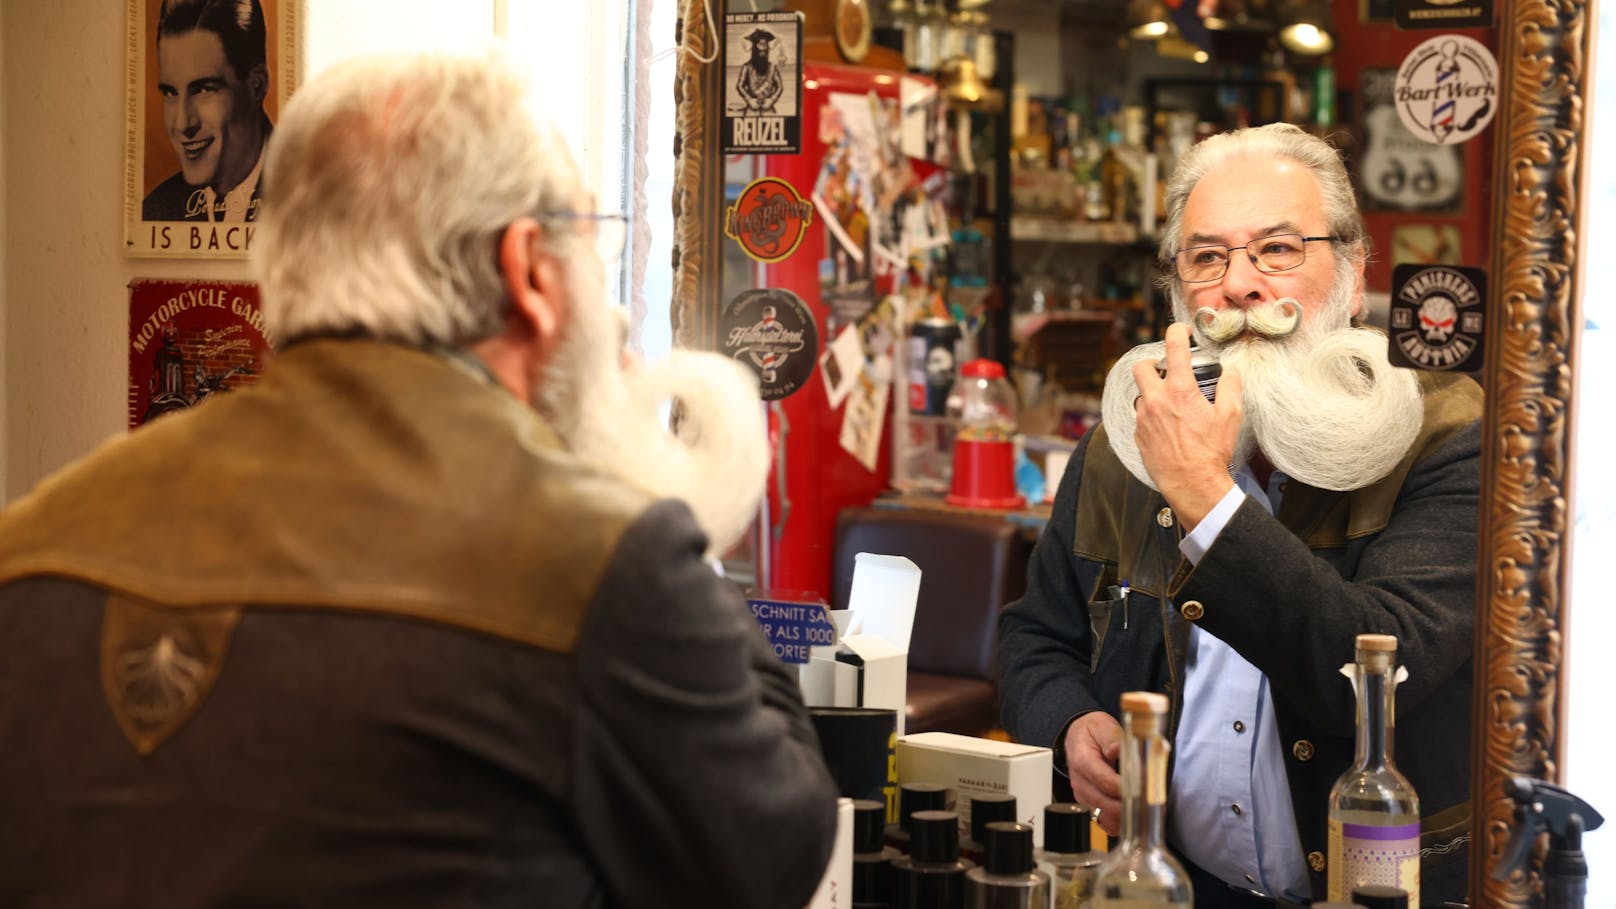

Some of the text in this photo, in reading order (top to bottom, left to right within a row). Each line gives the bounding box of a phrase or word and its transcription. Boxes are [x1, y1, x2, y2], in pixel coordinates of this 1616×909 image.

[733, 117, 788, 146] REUZEL
[151, 226, 256, 250] IS BACK
[132, 288, 274, 354] MOTORCYCLE GARA
[1403, 337, 1469, 366] AUSTRIA
[752, 603, 806, 622] SCHNITT
[776, 625, 800, 640] ALS
[805, 627, 834, 643] 1000
[769, 643, 807, 660] ORTE
